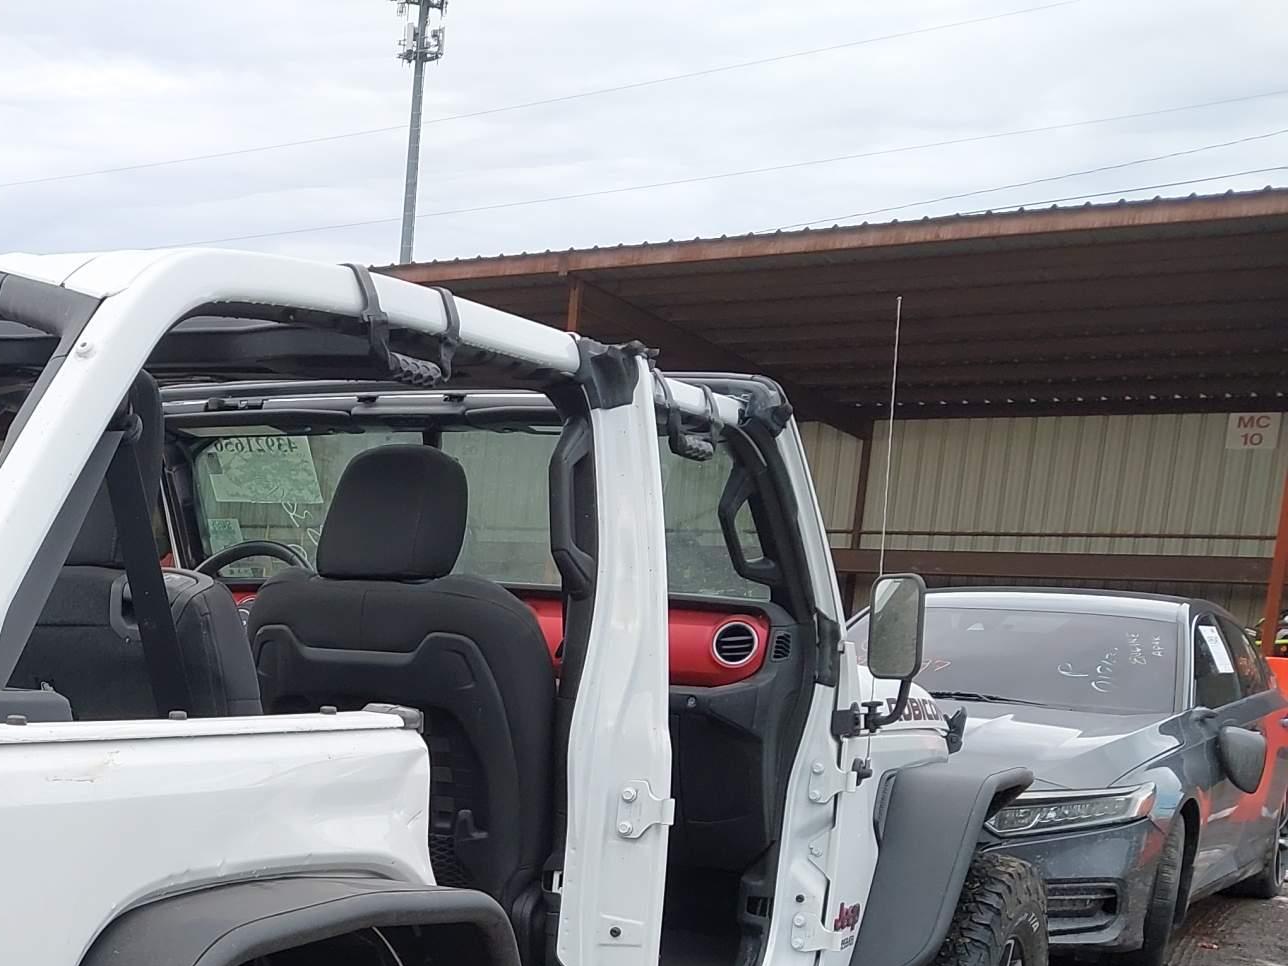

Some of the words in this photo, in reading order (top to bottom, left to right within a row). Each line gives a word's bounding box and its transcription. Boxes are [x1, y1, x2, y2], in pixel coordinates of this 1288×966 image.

[1237, 415, 1271, 429] MC
[1240, 432, 1264, 446] 10
[833, 902, 861, 931] Jeep
